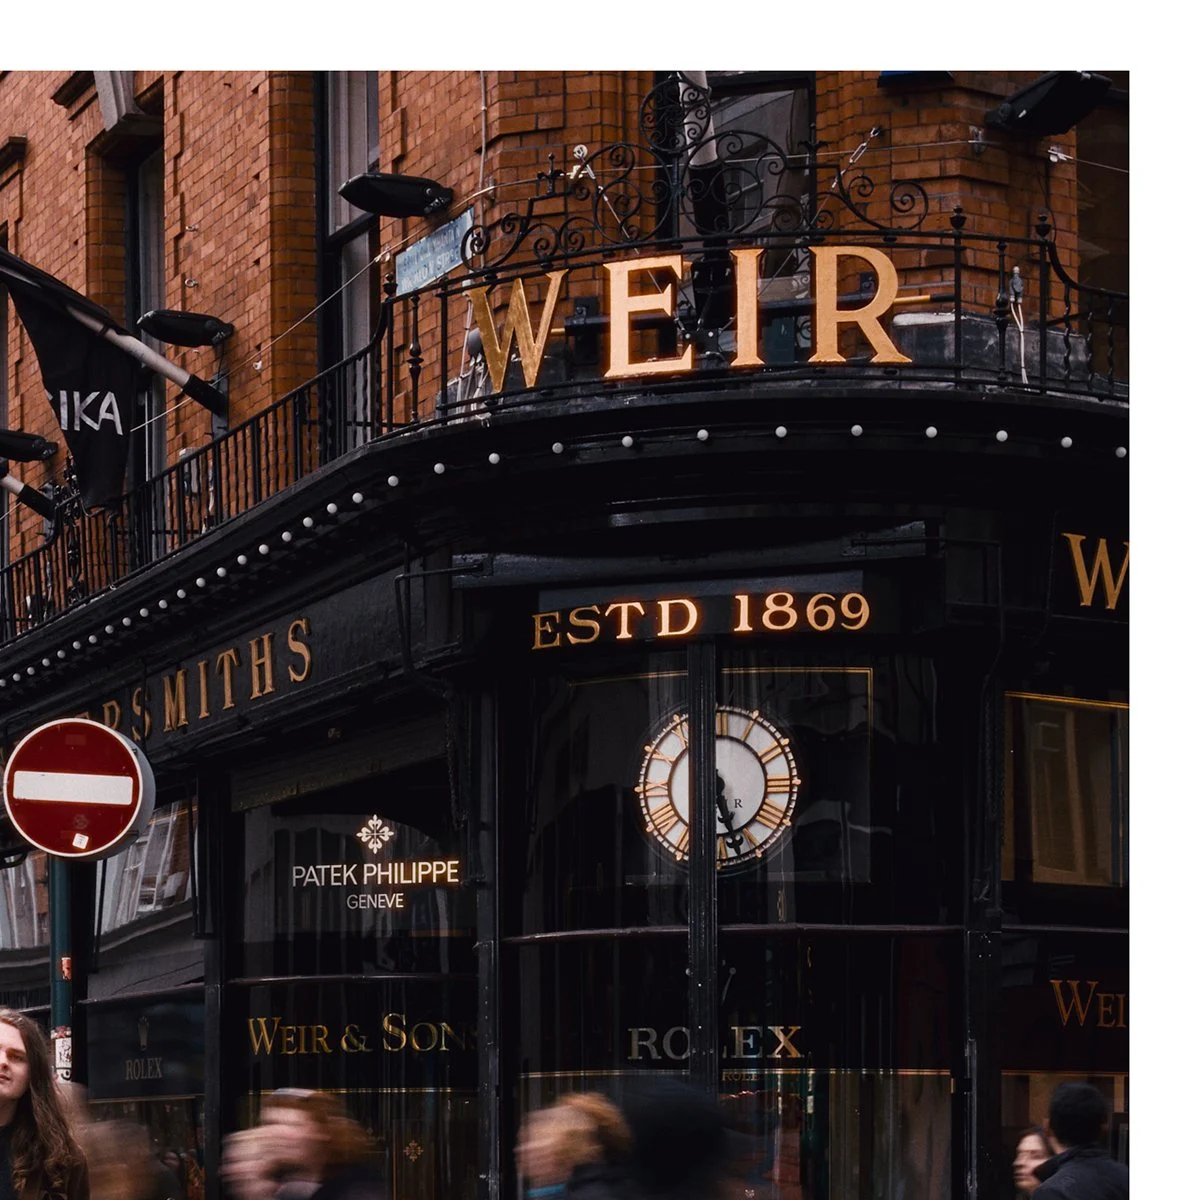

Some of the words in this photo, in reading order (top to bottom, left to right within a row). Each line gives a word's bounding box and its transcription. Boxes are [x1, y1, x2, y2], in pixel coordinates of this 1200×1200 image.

[466, 245, 913, 393] WEIR
[46, 389, 124, 436] IKA
[531, 598, 699, 650] ESTD
[733, 592, 871, 632] 1869
[292, 863, 358, 887] PATEK
[363, 860, 460, 885] PHILIPPE
[346, 893, 404, 910] GENEVE
[248, 1016, 332, 1056] WEIR
[340, 1024, 373, 1053] &
[627, 1025, 805, 1060] ROEX
[125, 1057, 163, 1081] ROLEX
